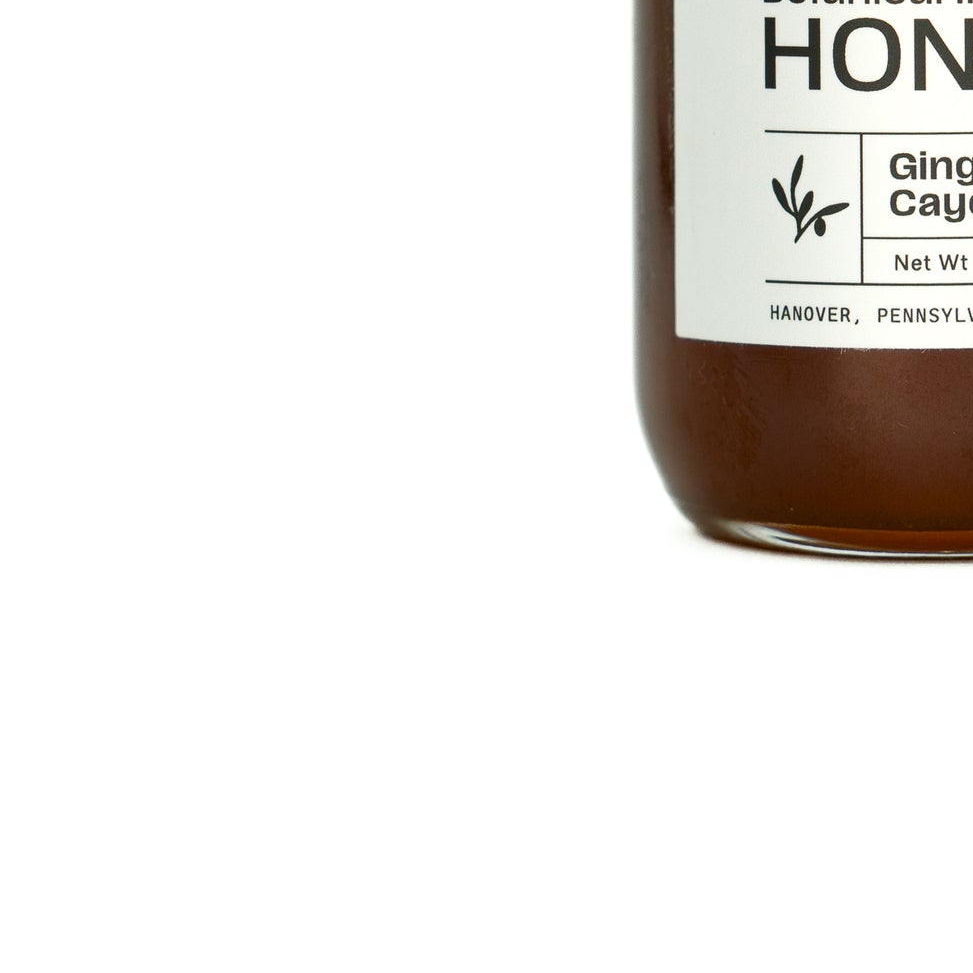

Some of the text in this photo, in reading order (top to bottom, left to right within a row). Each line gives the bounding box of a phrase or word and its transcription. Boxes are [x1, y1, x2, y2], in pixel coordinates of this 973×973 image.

[894, 254, 931, 272] Net
[938, 253, 968, 271] Wt
[770, 304, 859, 325] HANOVER,
